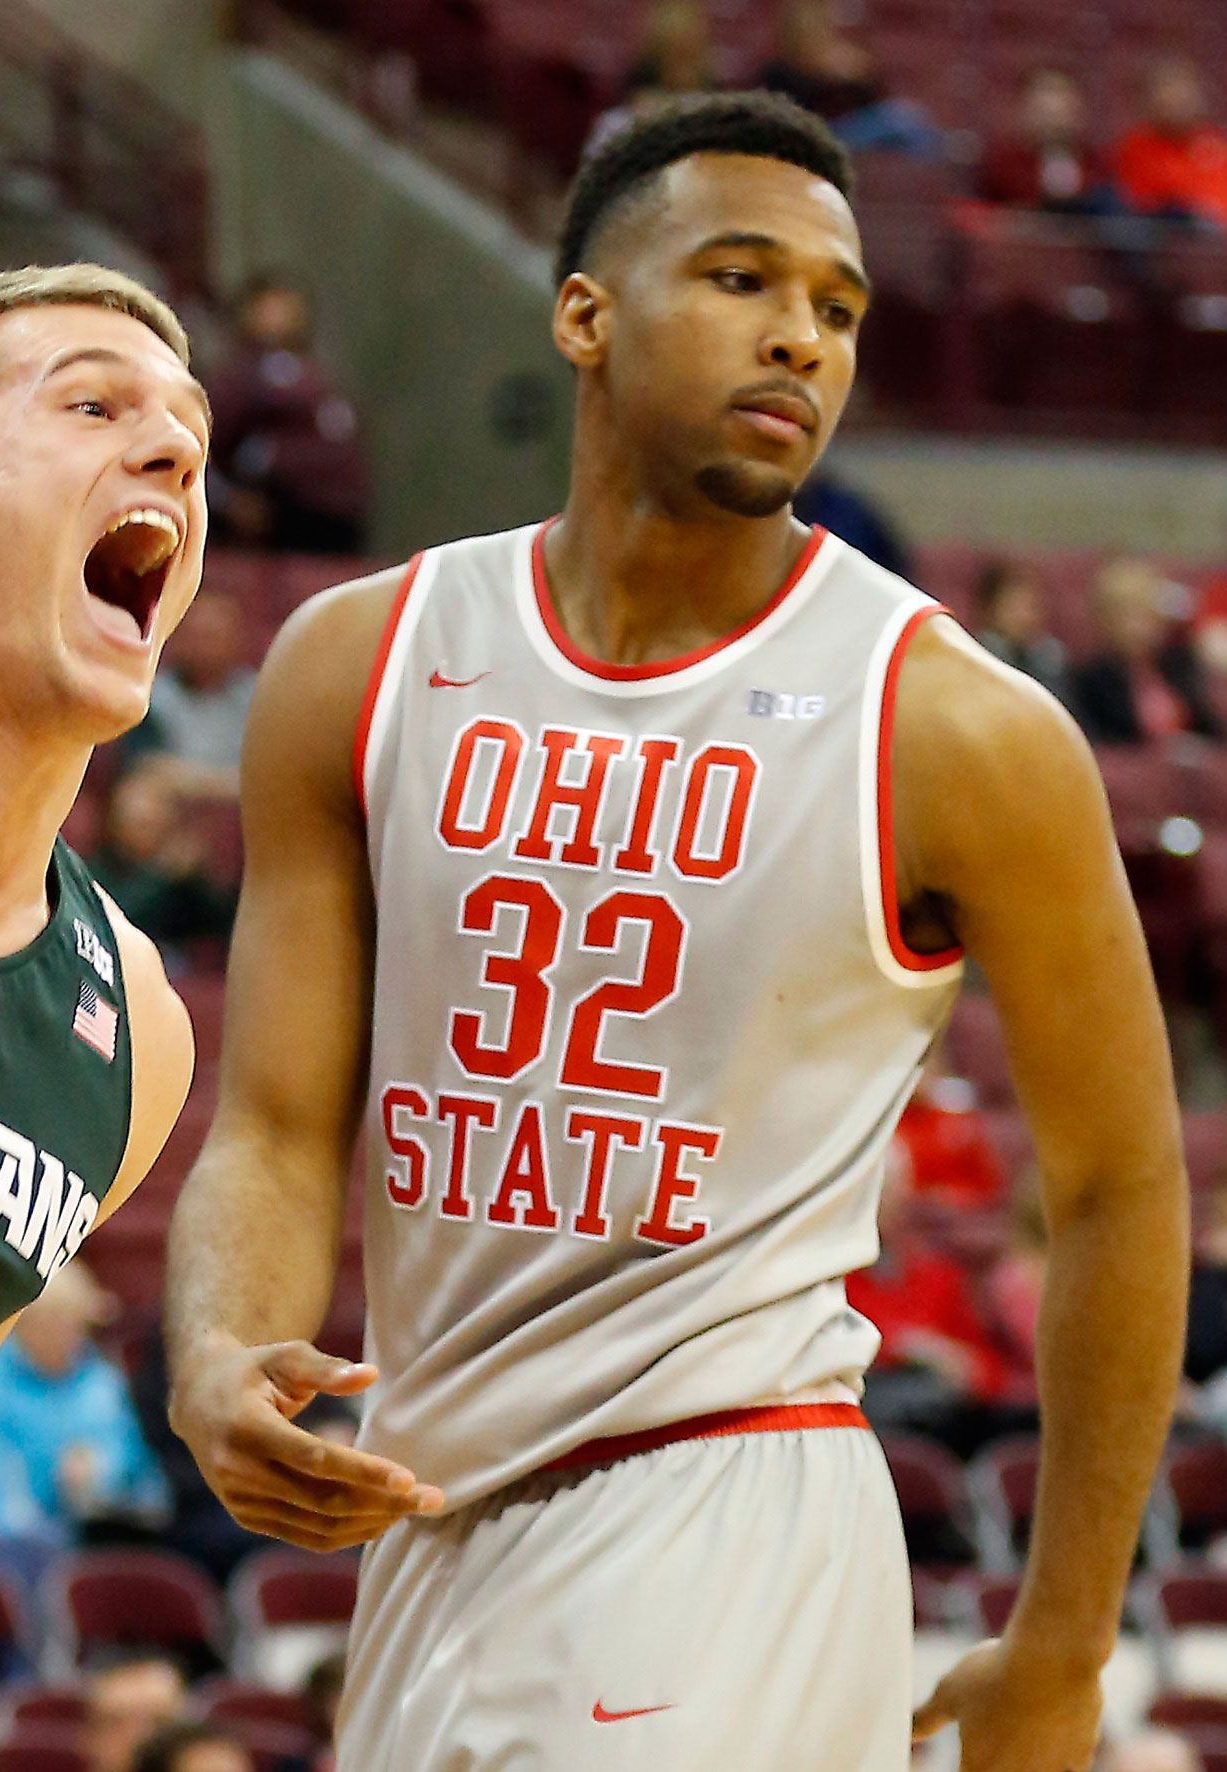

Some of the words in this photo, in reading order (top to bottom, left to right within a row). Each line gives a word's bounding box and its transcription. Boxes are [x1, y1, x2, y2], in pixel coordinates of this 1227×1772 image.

[435, 714, 762, 884] OHIO
[447, 871, 691, 1104] 32
[380, 1081, 725, 1247] STATE
